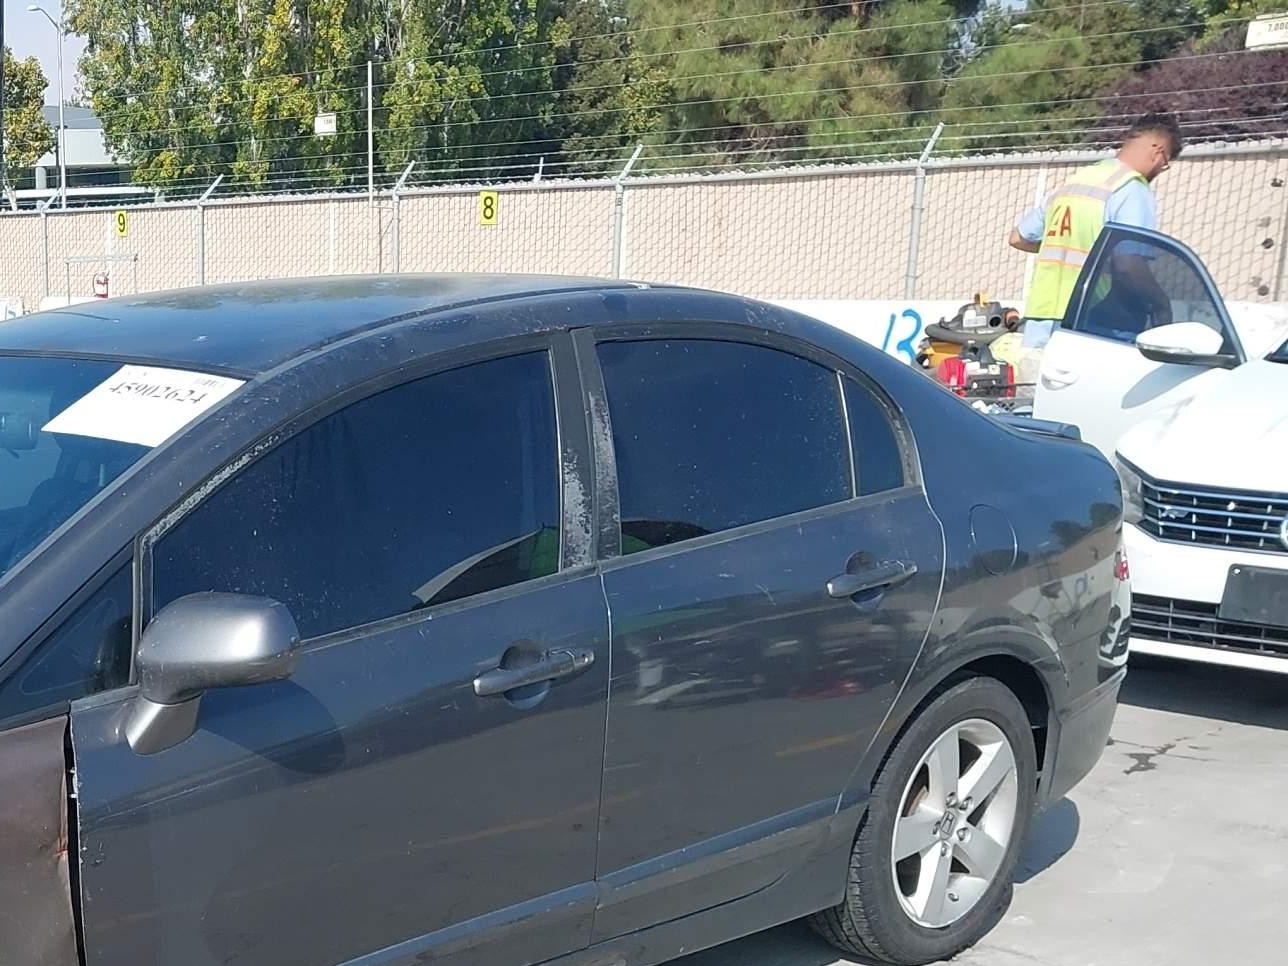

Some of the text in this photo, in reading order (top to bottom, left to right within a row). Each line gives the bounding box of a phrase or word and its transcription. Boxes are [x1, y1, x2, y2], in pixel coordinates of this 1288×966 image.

[483, 196, 494, 219] 8
[117, 213, 126, 232] 9
[882, 308, 922, 365] 13
